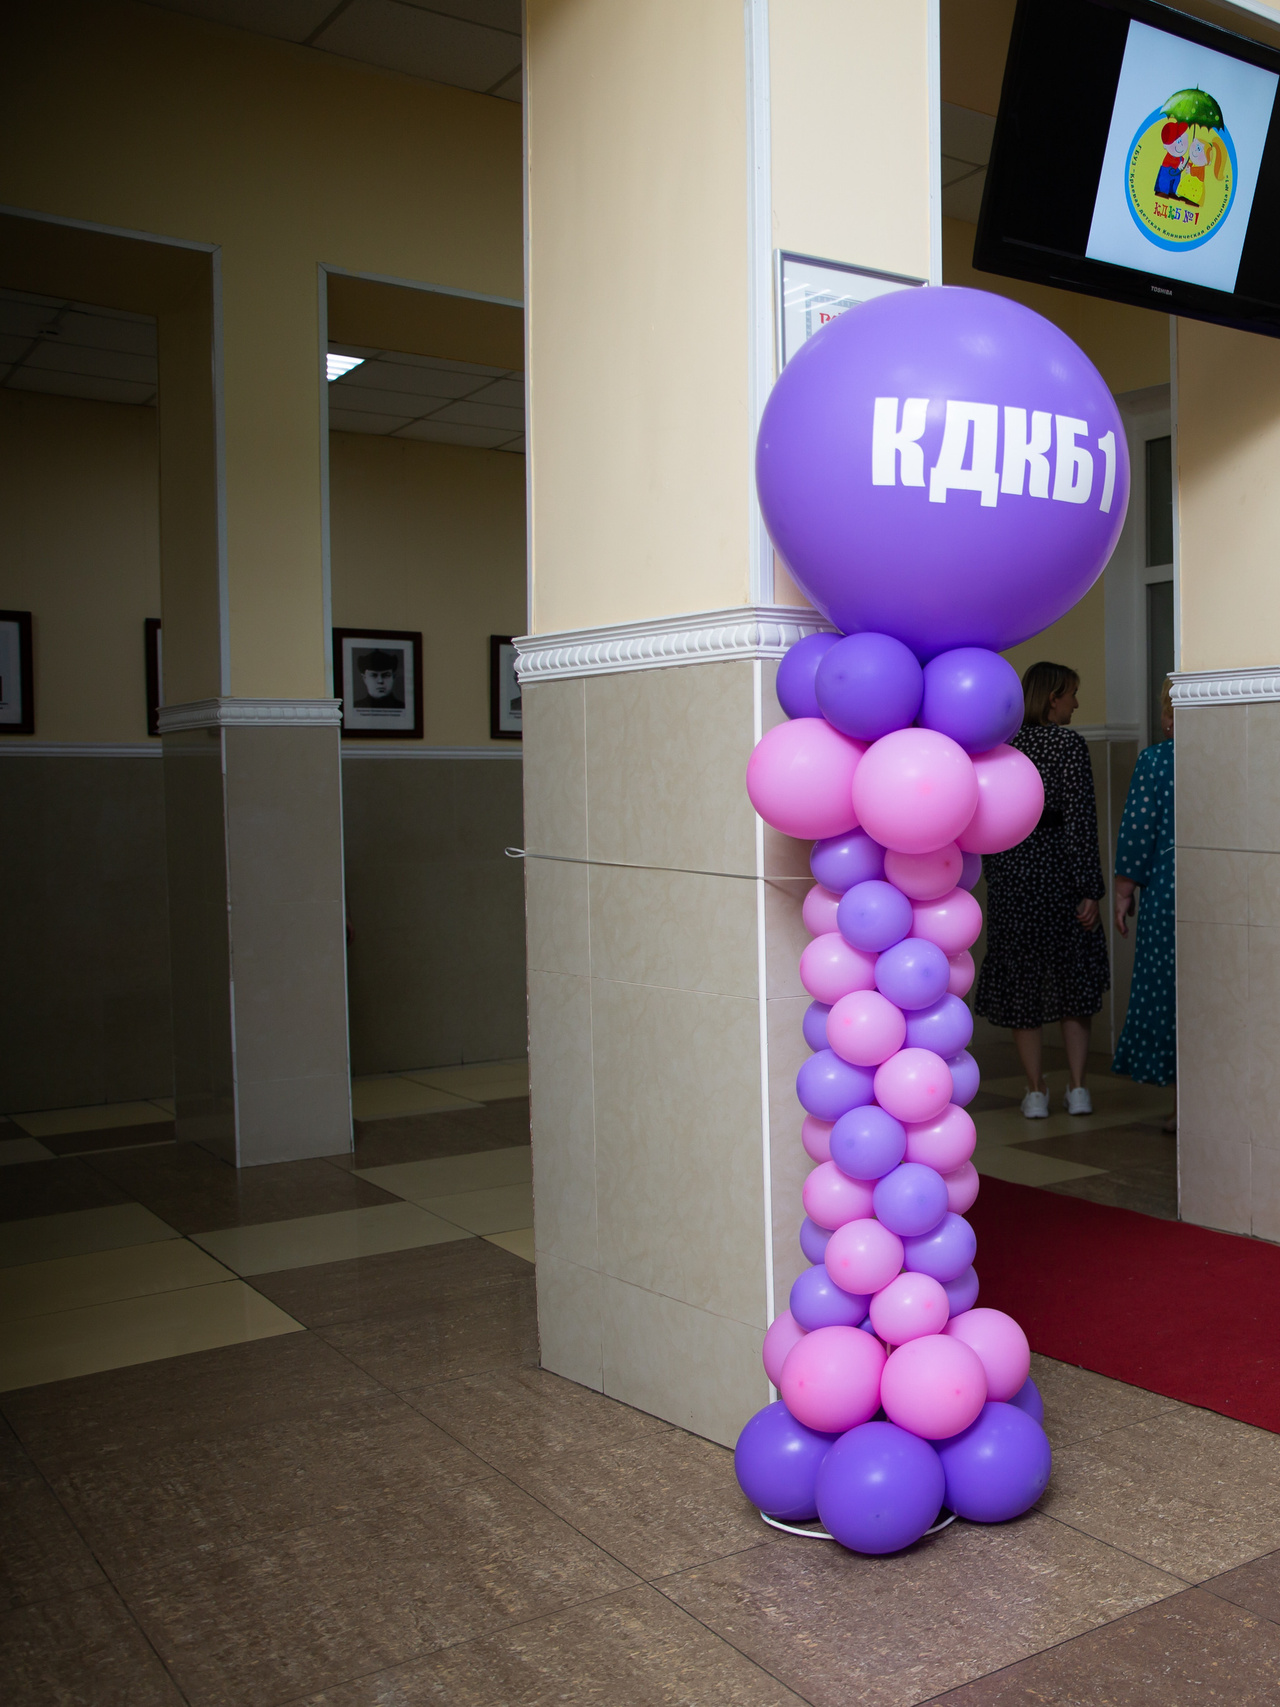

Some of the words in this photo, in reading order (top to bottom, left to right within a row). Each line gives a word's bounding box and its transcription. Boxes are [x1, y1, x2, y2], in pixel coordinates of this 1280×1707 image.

[1153, 201, 1182, 220] КДКБ
[1150, 285, 1173, 296] TOSHIBA
[872, 397, 1116, 514] КДКБ1
